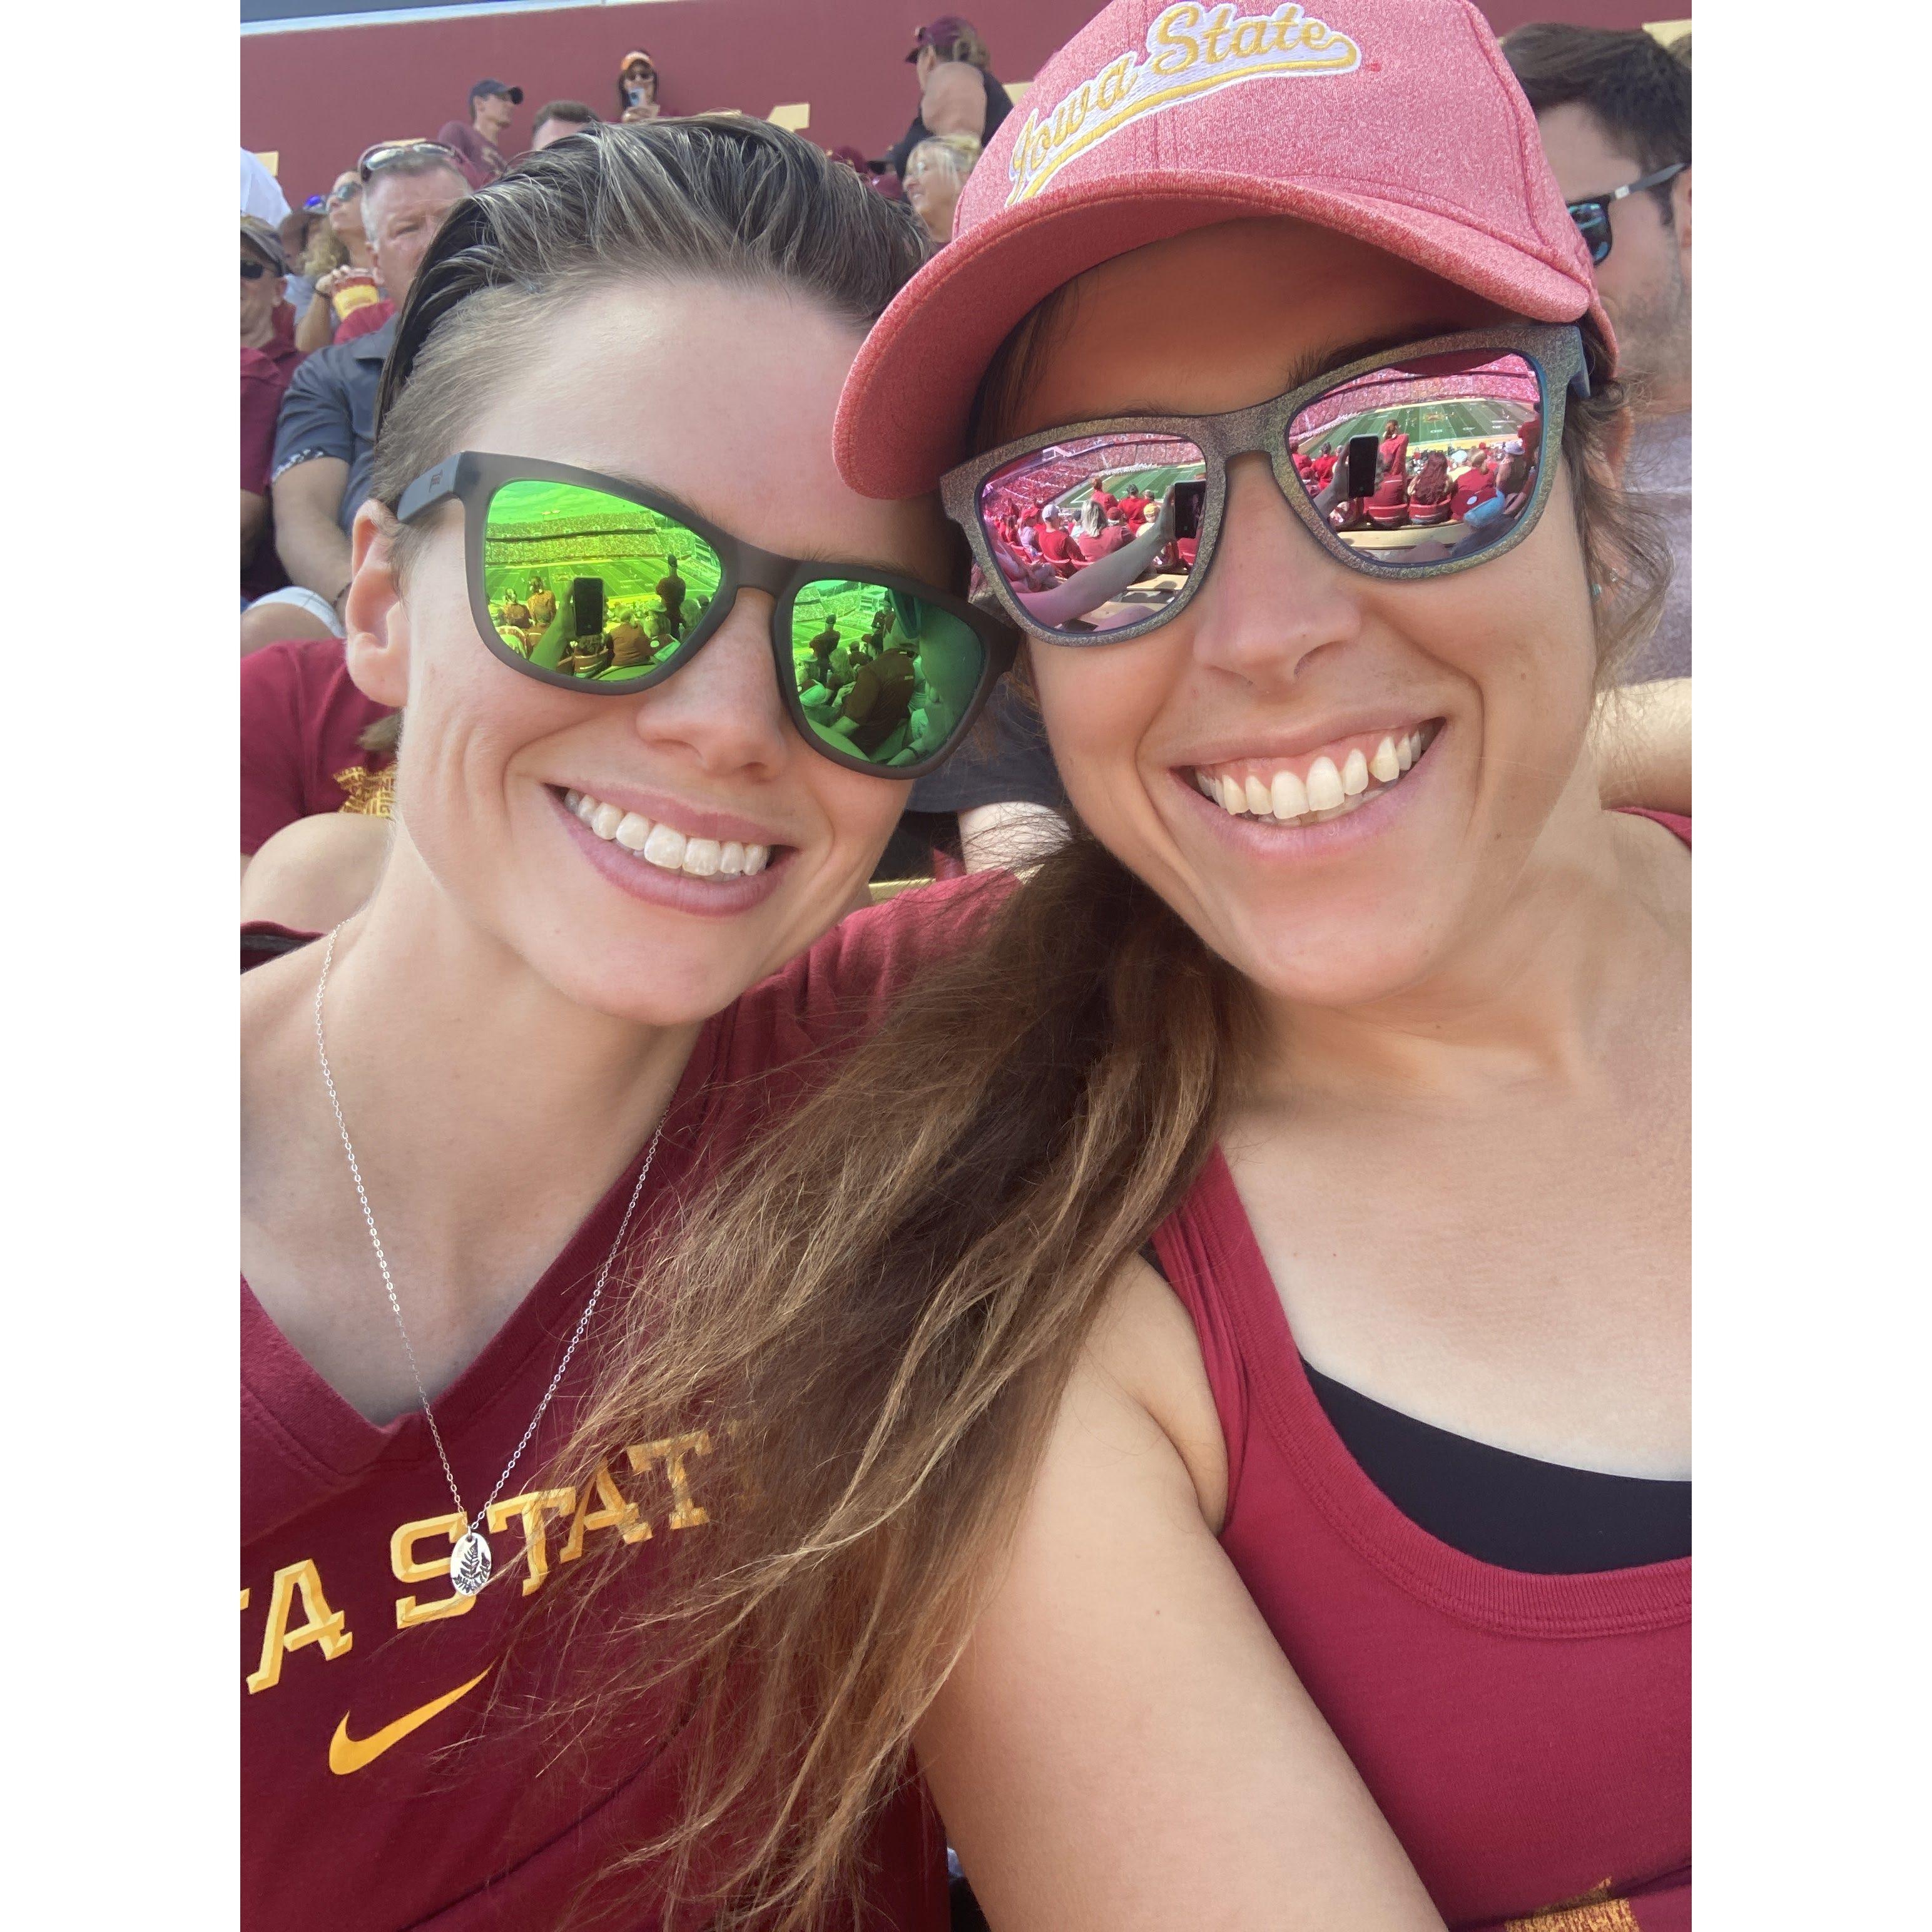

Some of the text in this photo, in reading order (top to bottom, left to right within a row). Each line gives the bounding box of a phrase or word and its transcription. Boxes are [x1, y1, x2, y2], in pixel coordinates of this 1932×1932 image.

[1007, 4, 1339, 206] Iowa State
[240, 1416, 763, 1694] A STAT
